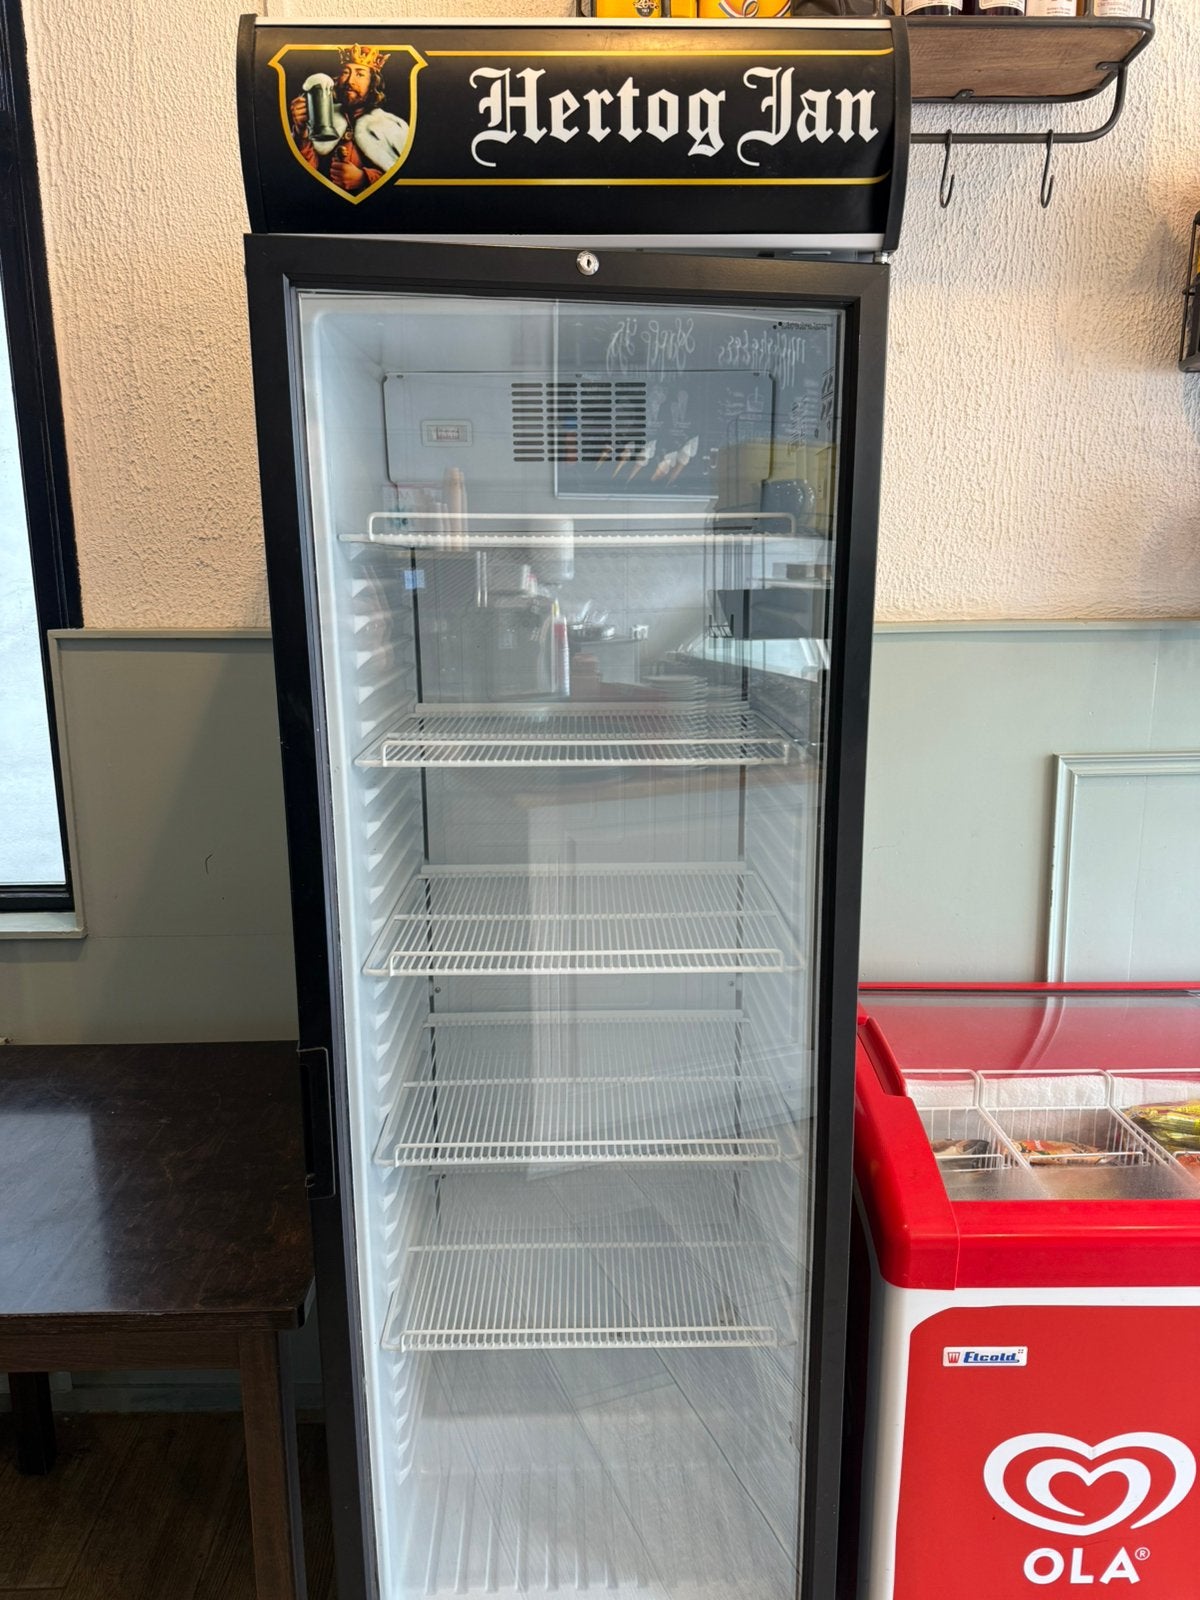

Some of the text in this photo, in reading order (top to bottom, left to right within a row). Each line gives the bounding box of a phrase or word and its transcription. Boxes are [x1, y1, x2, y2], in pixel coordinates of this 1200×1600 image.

[469, 66, 880, 168] Hertog Jan
[963, 1351, 1020, 1364] Elcold
